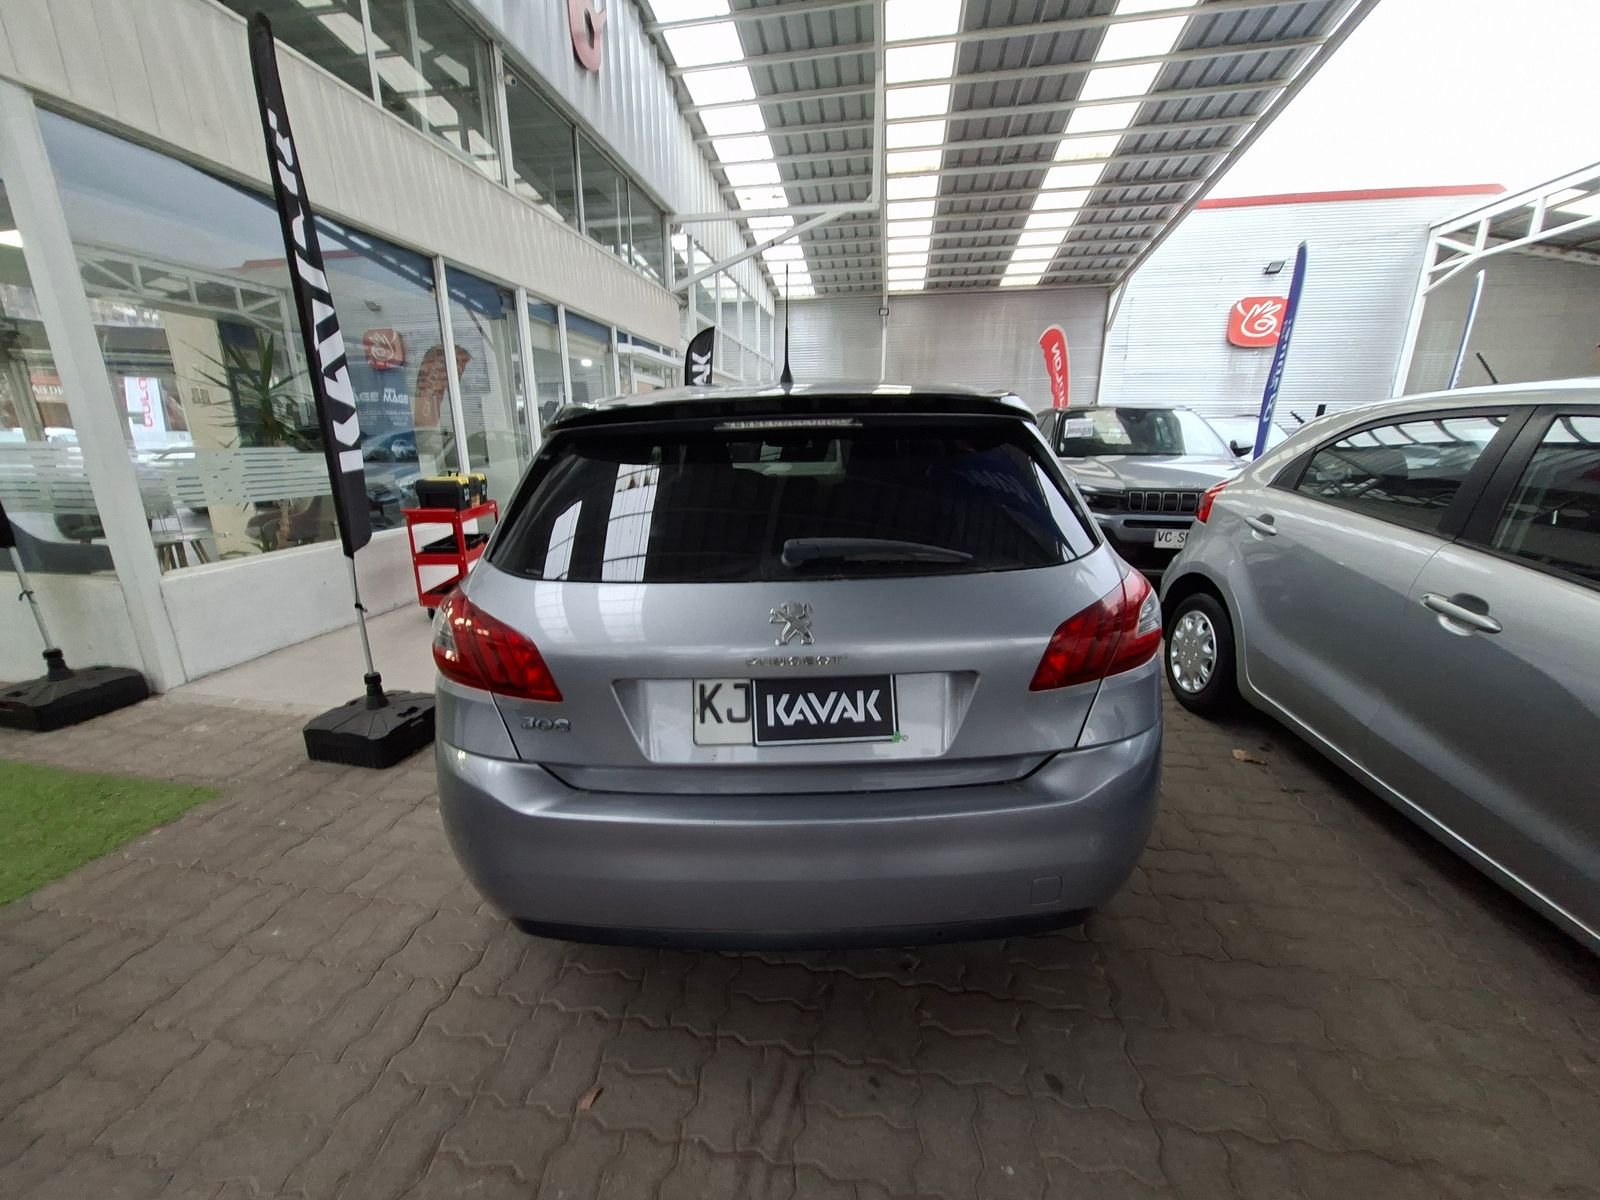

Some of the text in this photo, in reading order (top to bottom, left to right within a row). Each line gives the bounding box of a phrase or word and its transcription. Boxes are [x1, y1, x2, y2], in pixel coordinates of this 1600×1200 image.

[1157, 531, 1173, 543] VC
[699, 682, 751, 724] KJ
[766, 689, 882, 727] KAVAK
